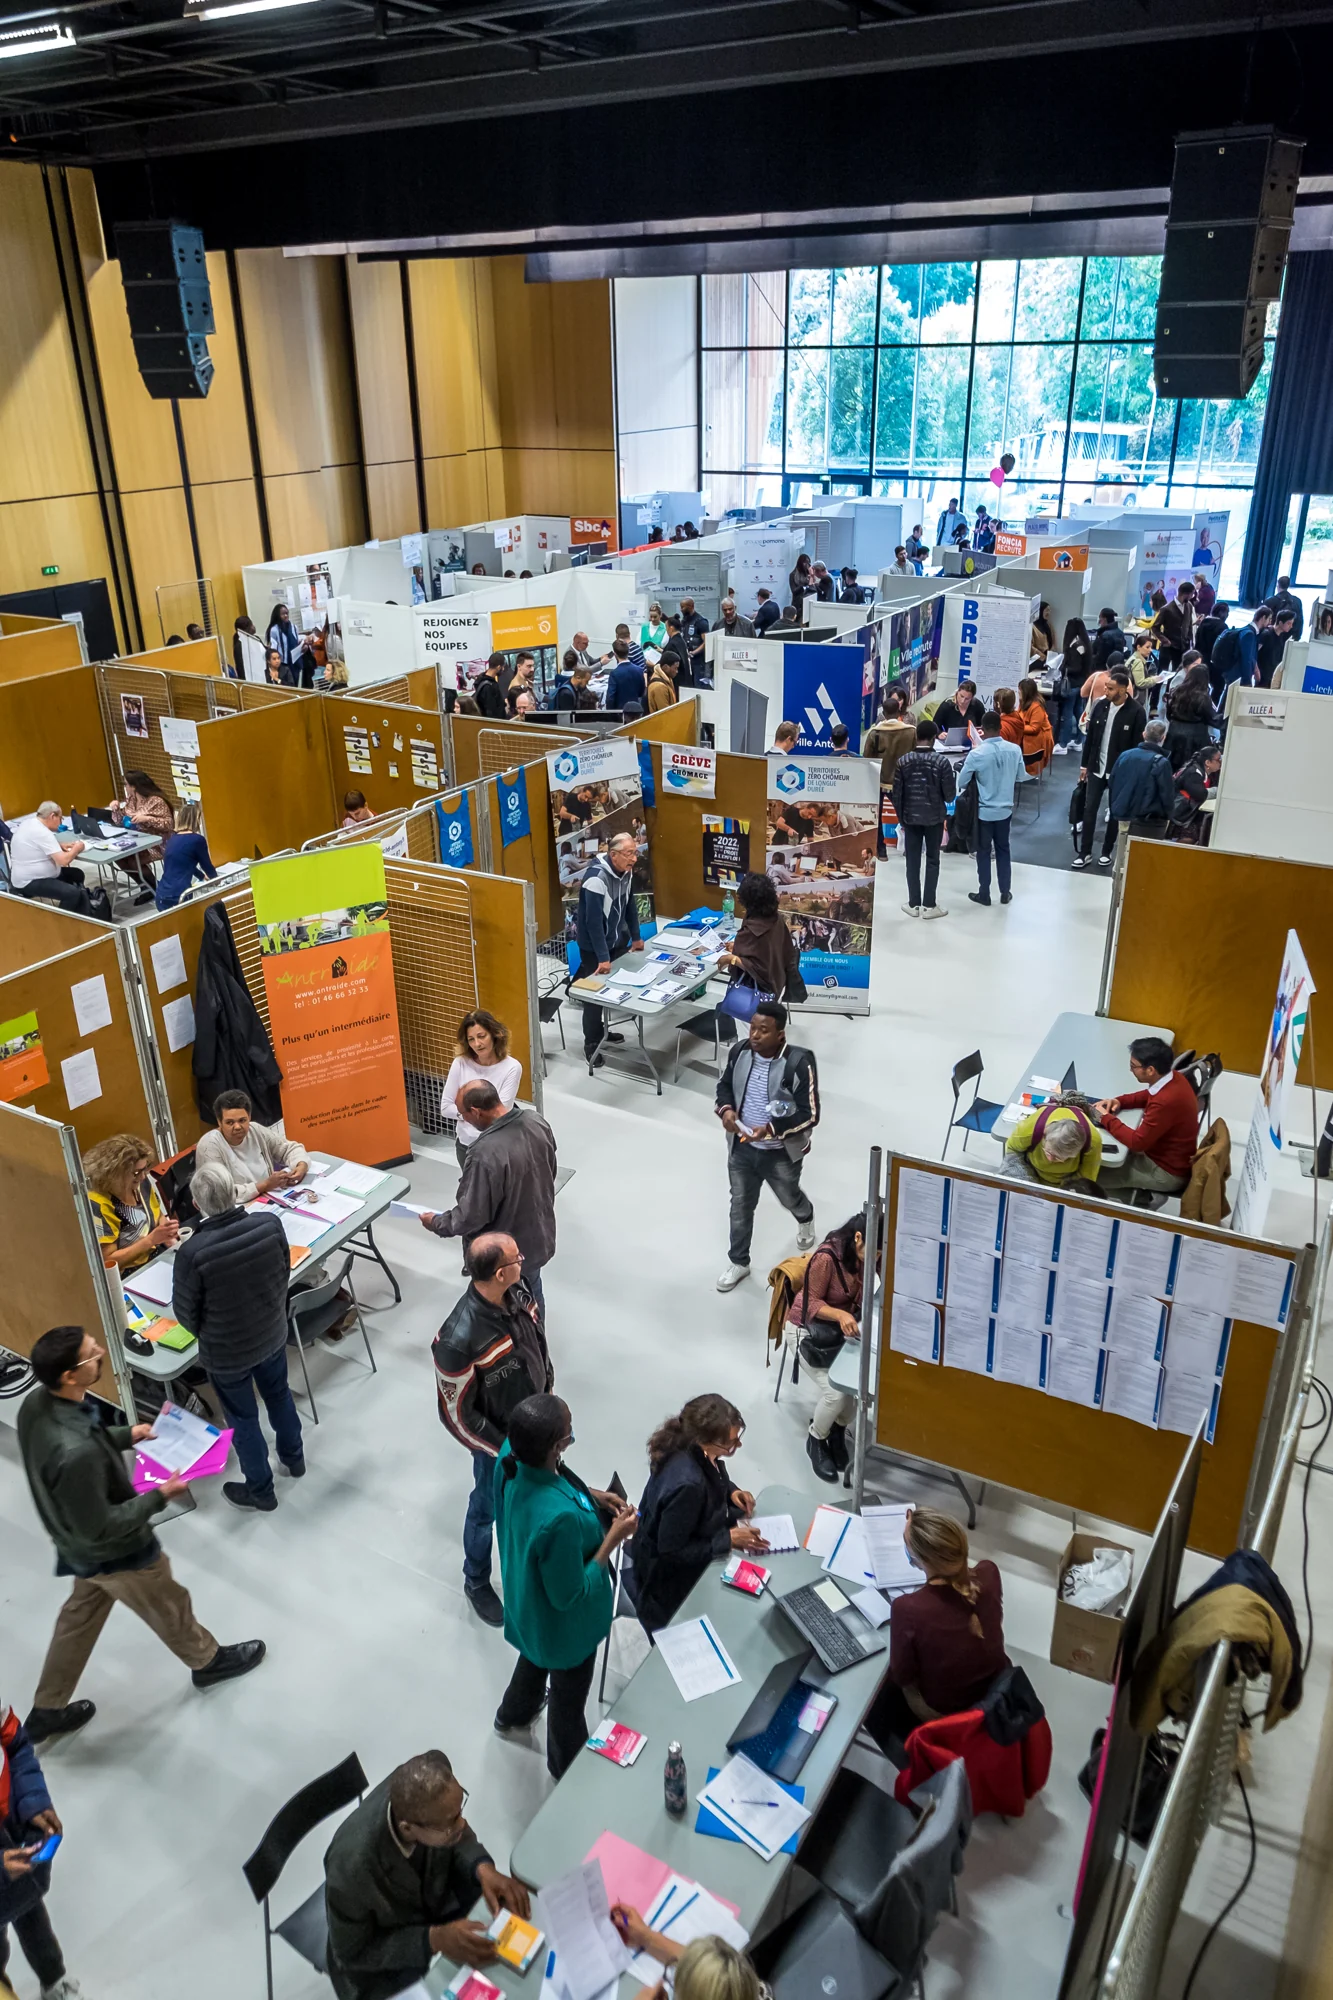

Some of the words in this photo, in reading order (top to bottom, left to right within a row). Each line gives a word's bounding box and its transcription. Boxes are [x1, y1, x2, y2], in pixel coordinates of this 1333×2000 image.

[574, 520, 600, 532] Sbc
[997, 536, 1022, 548] FONCIA
[996, 544, 1022, 556] RECRUTE
[424, 618, 479, 626] REJOIGNEZ
[424, 630, 445, 638] NOS
[426, 642, 468, 651] ÉQUIPES
[893, 656, 899, 667] La
[901, 649, 912, 662] Ville
[914, 640, 932, 657] recrute
[1248, 704, 1268, 714] ALLÉE
[1268, 706, 1273, 714] A
[814, 740, 835, 748] Anto
[579, 746, 605, 756] TERRITOIRES
[591, 752, 613, 762] CHÔMEUR
[672, 754, 711, 768] GRÈVE
[586, 760, 604, 768] LONGUE
[581, 768, 595, 776] DURÉE
[672, 769, 708, 779] CHÔMAGE
[822, 773, 850, 781] CHÔMEUR
[295, 978, 366, 999] www.antraide.com
[294, 1001, 304, 1009] Tel
[348, 988, 356, 996] 32
[807, 992, 858, 1000] ld.antony@gmail.com
[282, 1036, 301, 1045] Plus
[303, 1028, 329, 1042] qu'un
[332, 1012, 390, 1033] intermédiaire
[287, 1066, 300, 1074] pour
[310, 1055, 340, 1068] particuliers
[356, 1040, 394, 1056] professionnels
[301, 1054, 322, 1063] services
[300, 1111, 330, 1123] Déduction
[332, 1105, 349, 1114] fiscale
[372, 1095, 388, 1103] cadre
[319, 1116, 341, 1125] services
[484, 1358, 521, 1388] STR
